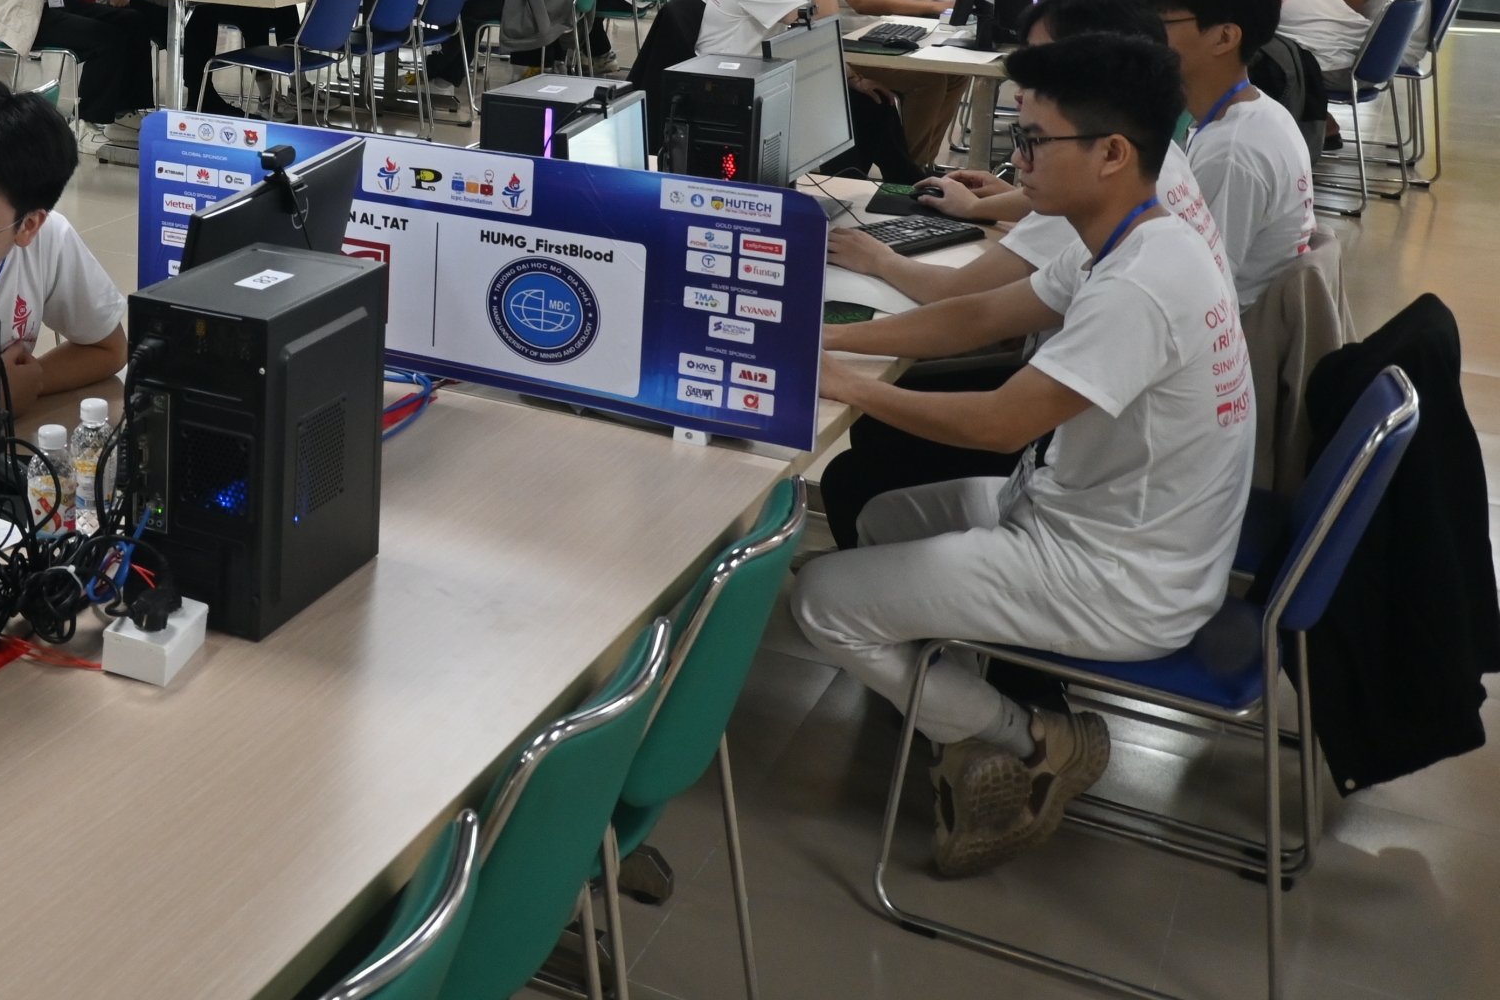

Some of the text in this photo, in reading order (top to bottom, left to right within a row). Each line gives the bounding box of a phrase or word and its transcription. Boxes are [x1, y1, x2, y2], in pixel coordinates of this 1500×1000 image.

[181, 150, 228, 161] GLOBAL SPONSOR
[164, 200, 195, 211] viettel
[725, 198, 772, 213] HUTECH
[715, 222, 761, 233] GOLD SPONSOR
[360, 212, 409, 231] AI_TAT
[480, 230, 614, 263] HUMG_FirstBlood
[708, 242, 729, 250] GROUP
[753, 265, 780, 280] funtap
[711, 283, 758, 295] SILVER SPONSOR
[694, 291, 714, 302] TMA
[499, 325, 530, 354] UNIVERSITY
[529, 349, 539, 357] OF
[539, 351, 563, 359] MINING
[562, 346, 576, 357] AND
[575, 321, 593, 349] GEOLOGY
[705, 346, 756, 360] BRONZE SPONSOR
[695, 362, 768, 383] KMS Mi2
